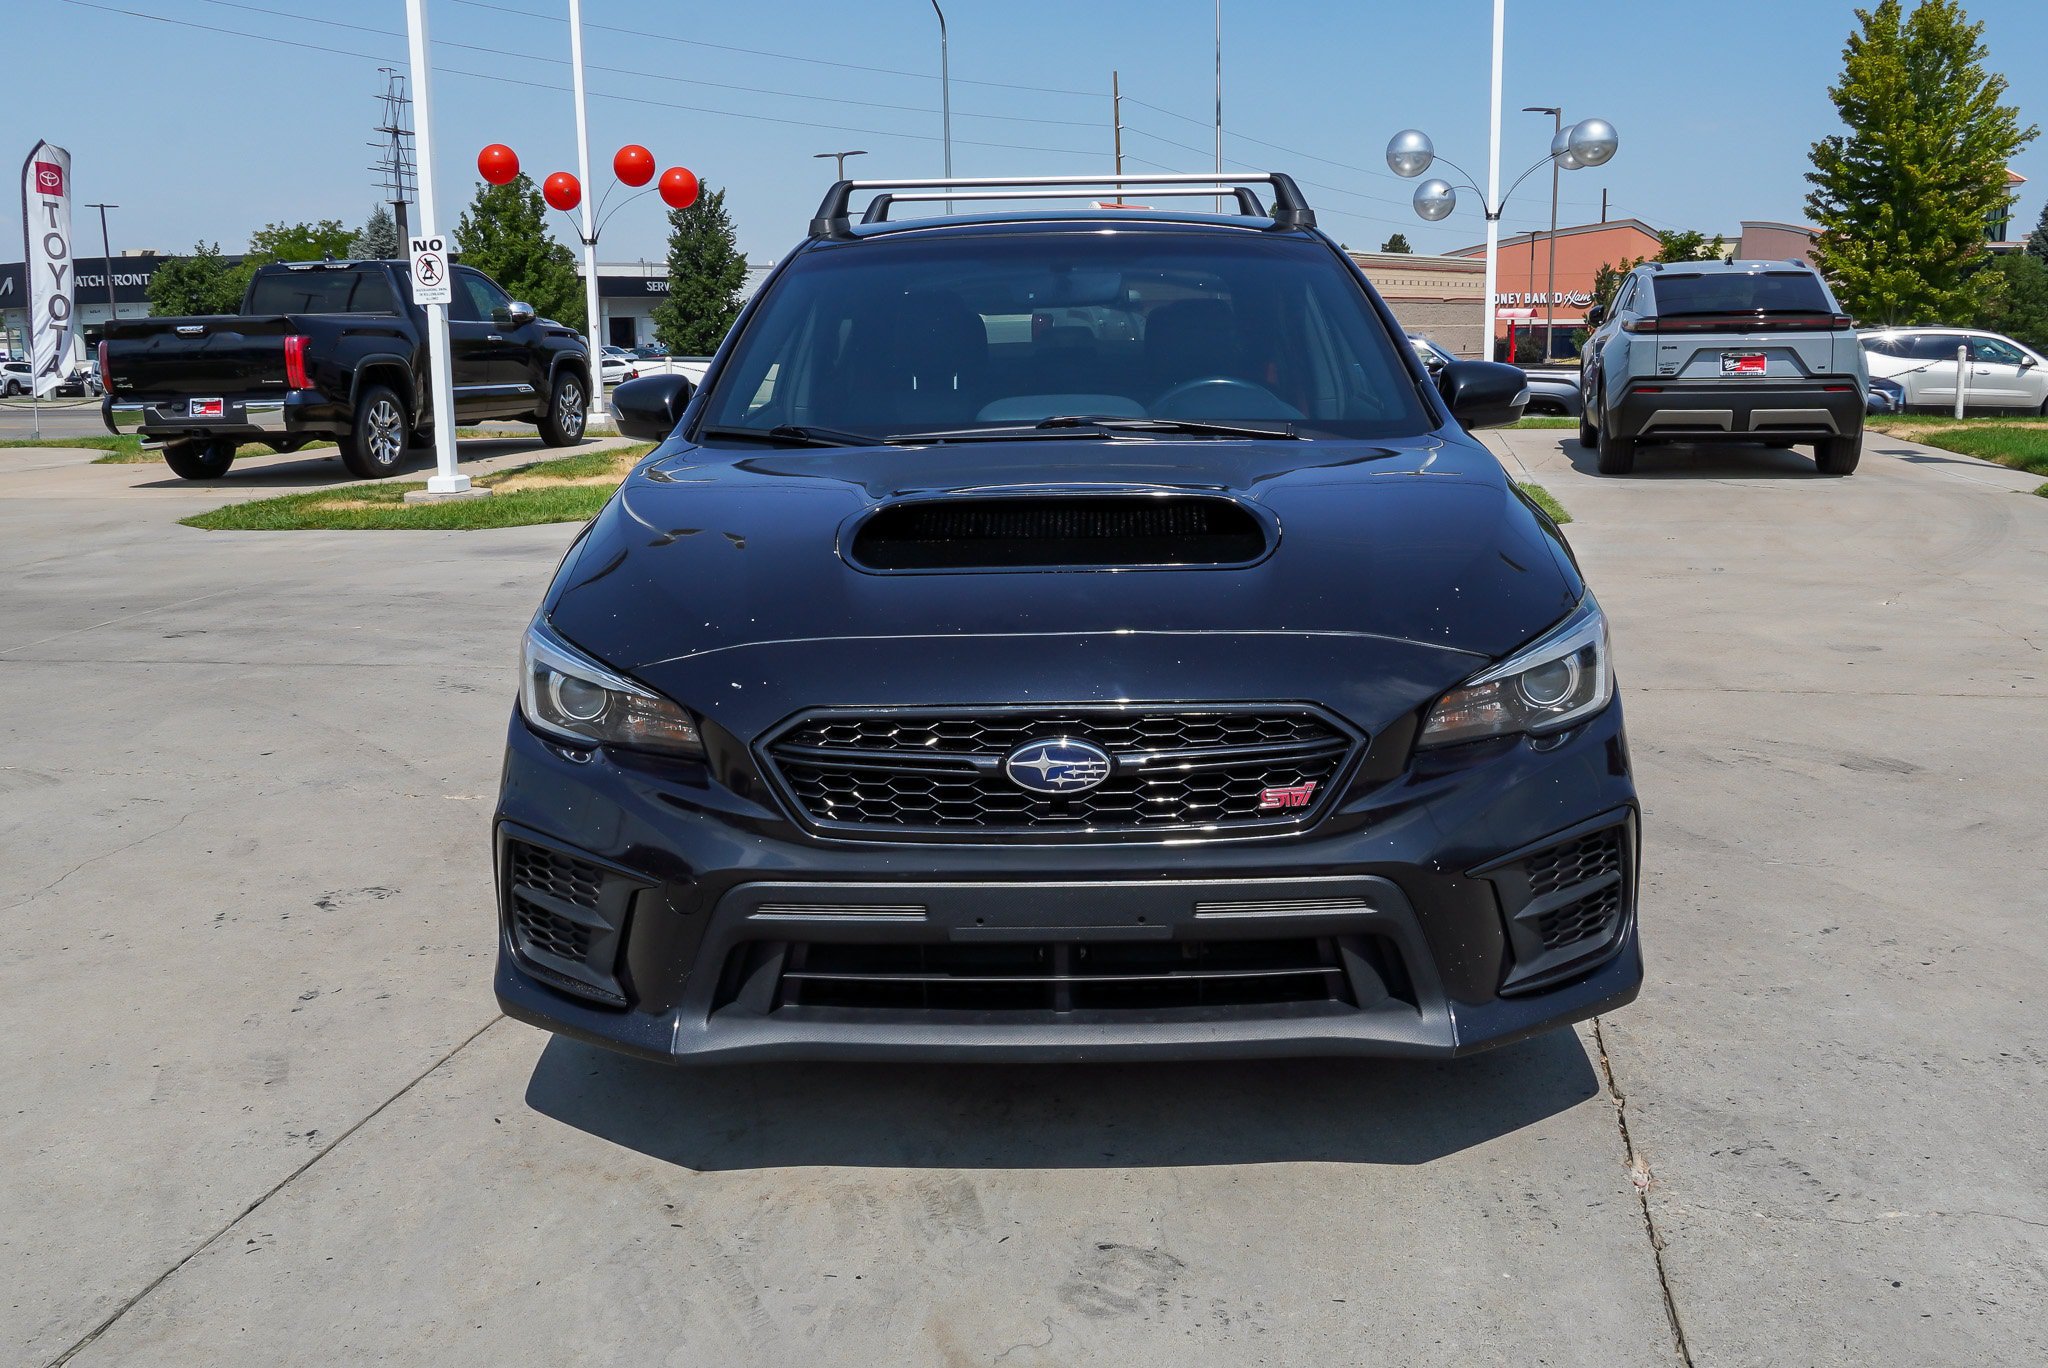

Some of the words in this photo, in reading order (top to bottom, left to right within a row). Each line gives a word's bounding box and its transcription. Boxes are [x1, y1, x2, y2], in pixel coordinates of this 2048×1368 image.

[413, 239, 443, 252] NO
[74, 275, 104, 287] ATCH
[646, 281, 671, 292] SERV
[40, 201, 71, 379] TOYOTA
[1494, 293, 1521, 304] ONEY
[1563, 290, 1593, 306] Ham
